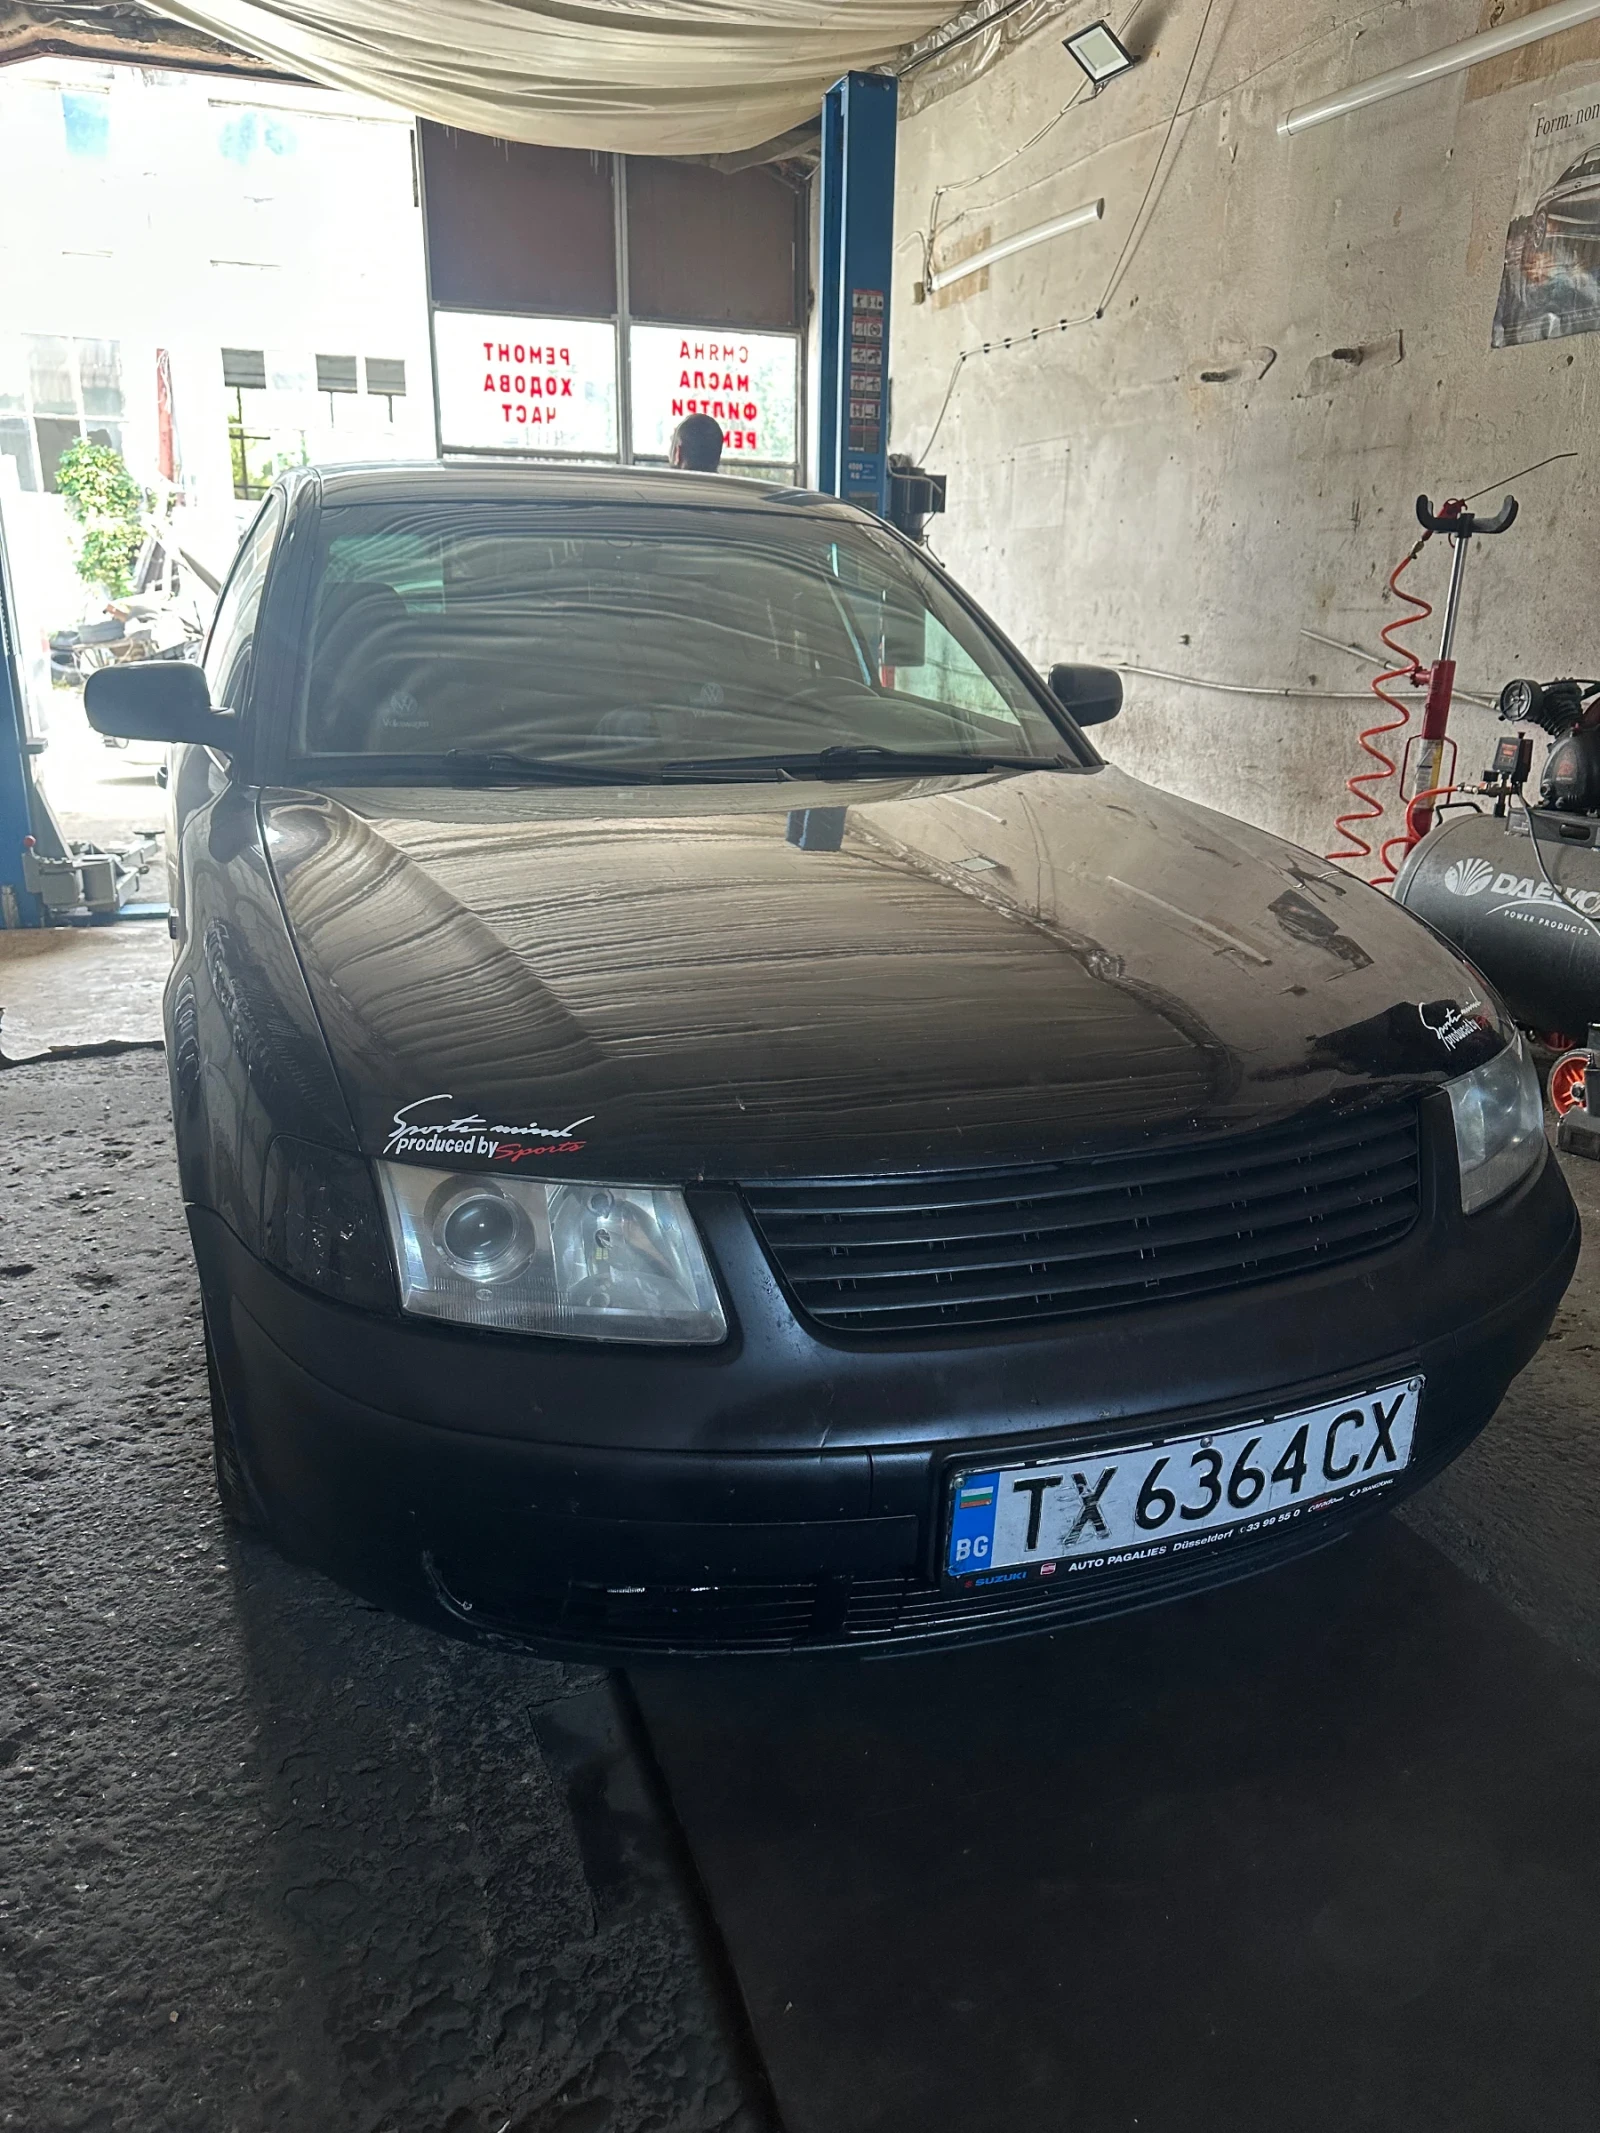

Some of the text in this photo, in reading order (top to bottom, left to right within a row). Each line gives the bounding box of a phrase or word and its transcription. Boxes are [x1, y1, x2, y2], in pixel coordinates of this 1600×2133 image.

[1535, 114, 1573, 138] Form:
[1504, 910, 1590, 936] POWER PRODUCTS
[395, 1134, 587, 1163] produced by Sports
[955, 1535, 990, 1562] BG
[1068, 1508, 1301, 1572] AUTO PAGALIES Düsseldorf 33 99 55 0
[974, 1571, 1028, 1587] SUZUKI
